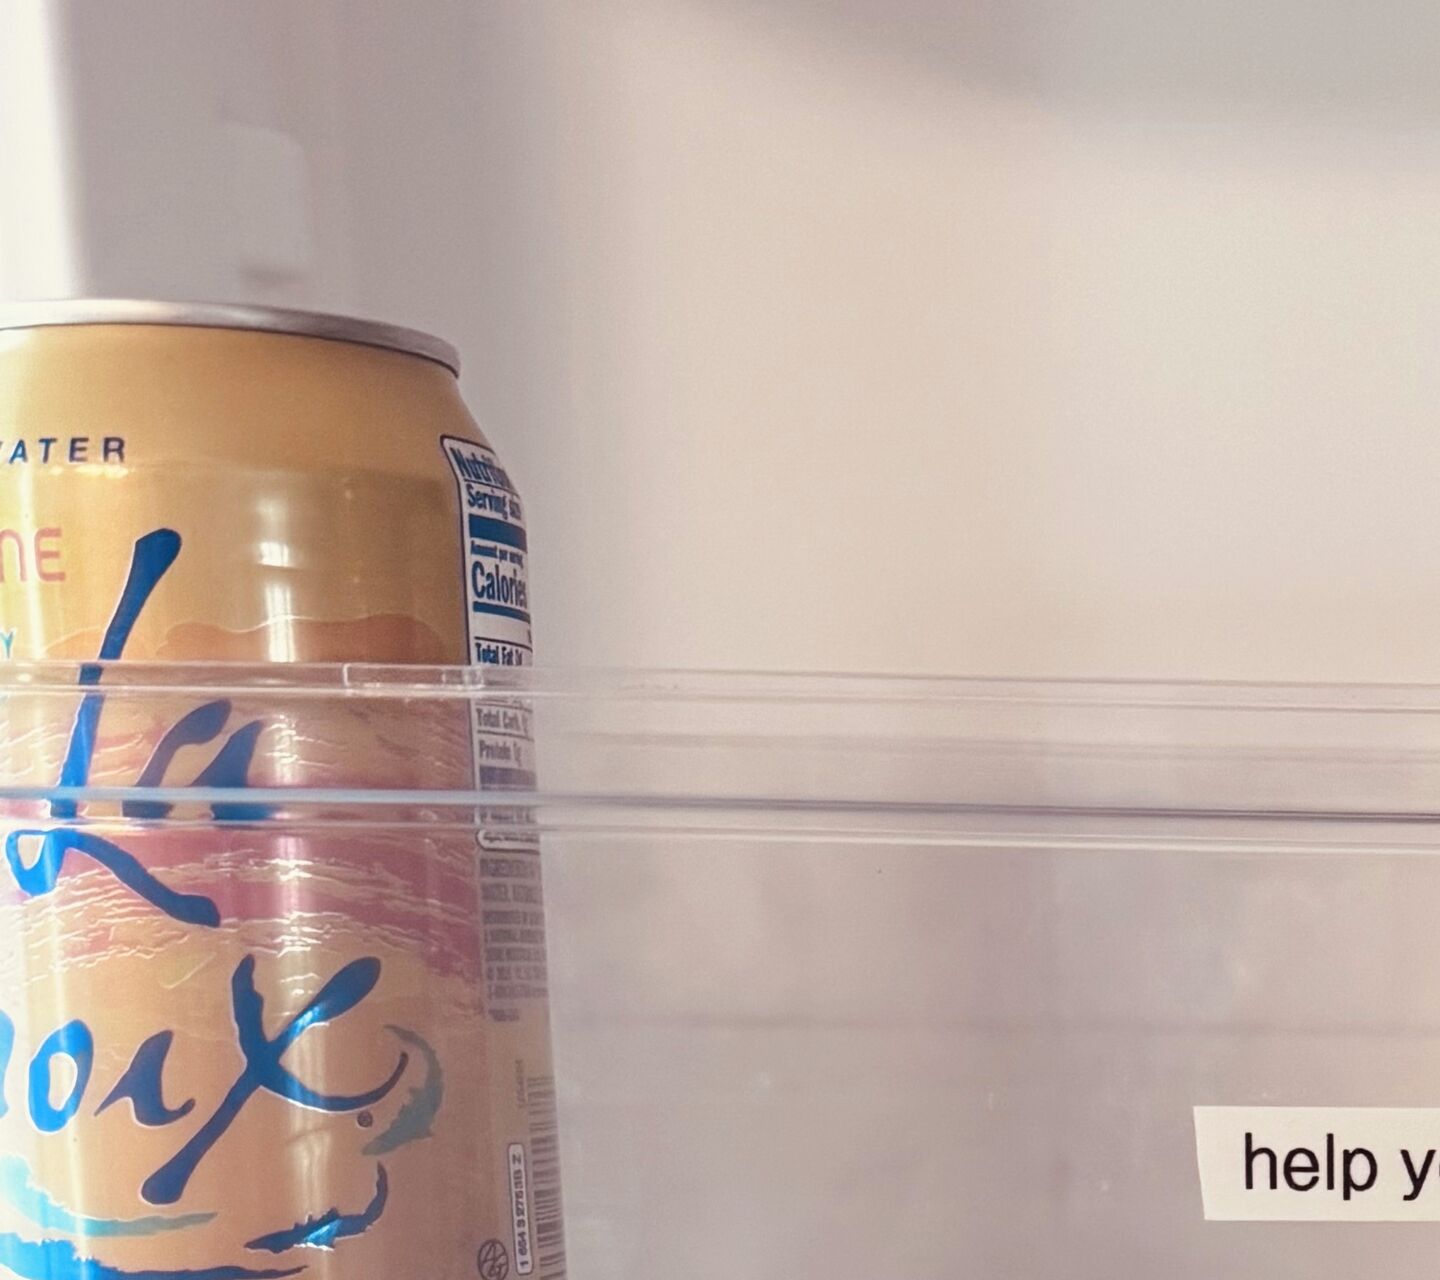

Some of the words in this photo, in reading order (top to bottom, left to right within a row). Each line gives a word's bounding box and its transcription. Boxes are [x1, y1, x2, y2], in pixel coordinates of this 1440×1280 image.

[0, 436, 126, 464] ATER
[472, 561, 529, 609] Calories
[1243, 1131, 1379, 1201] help
